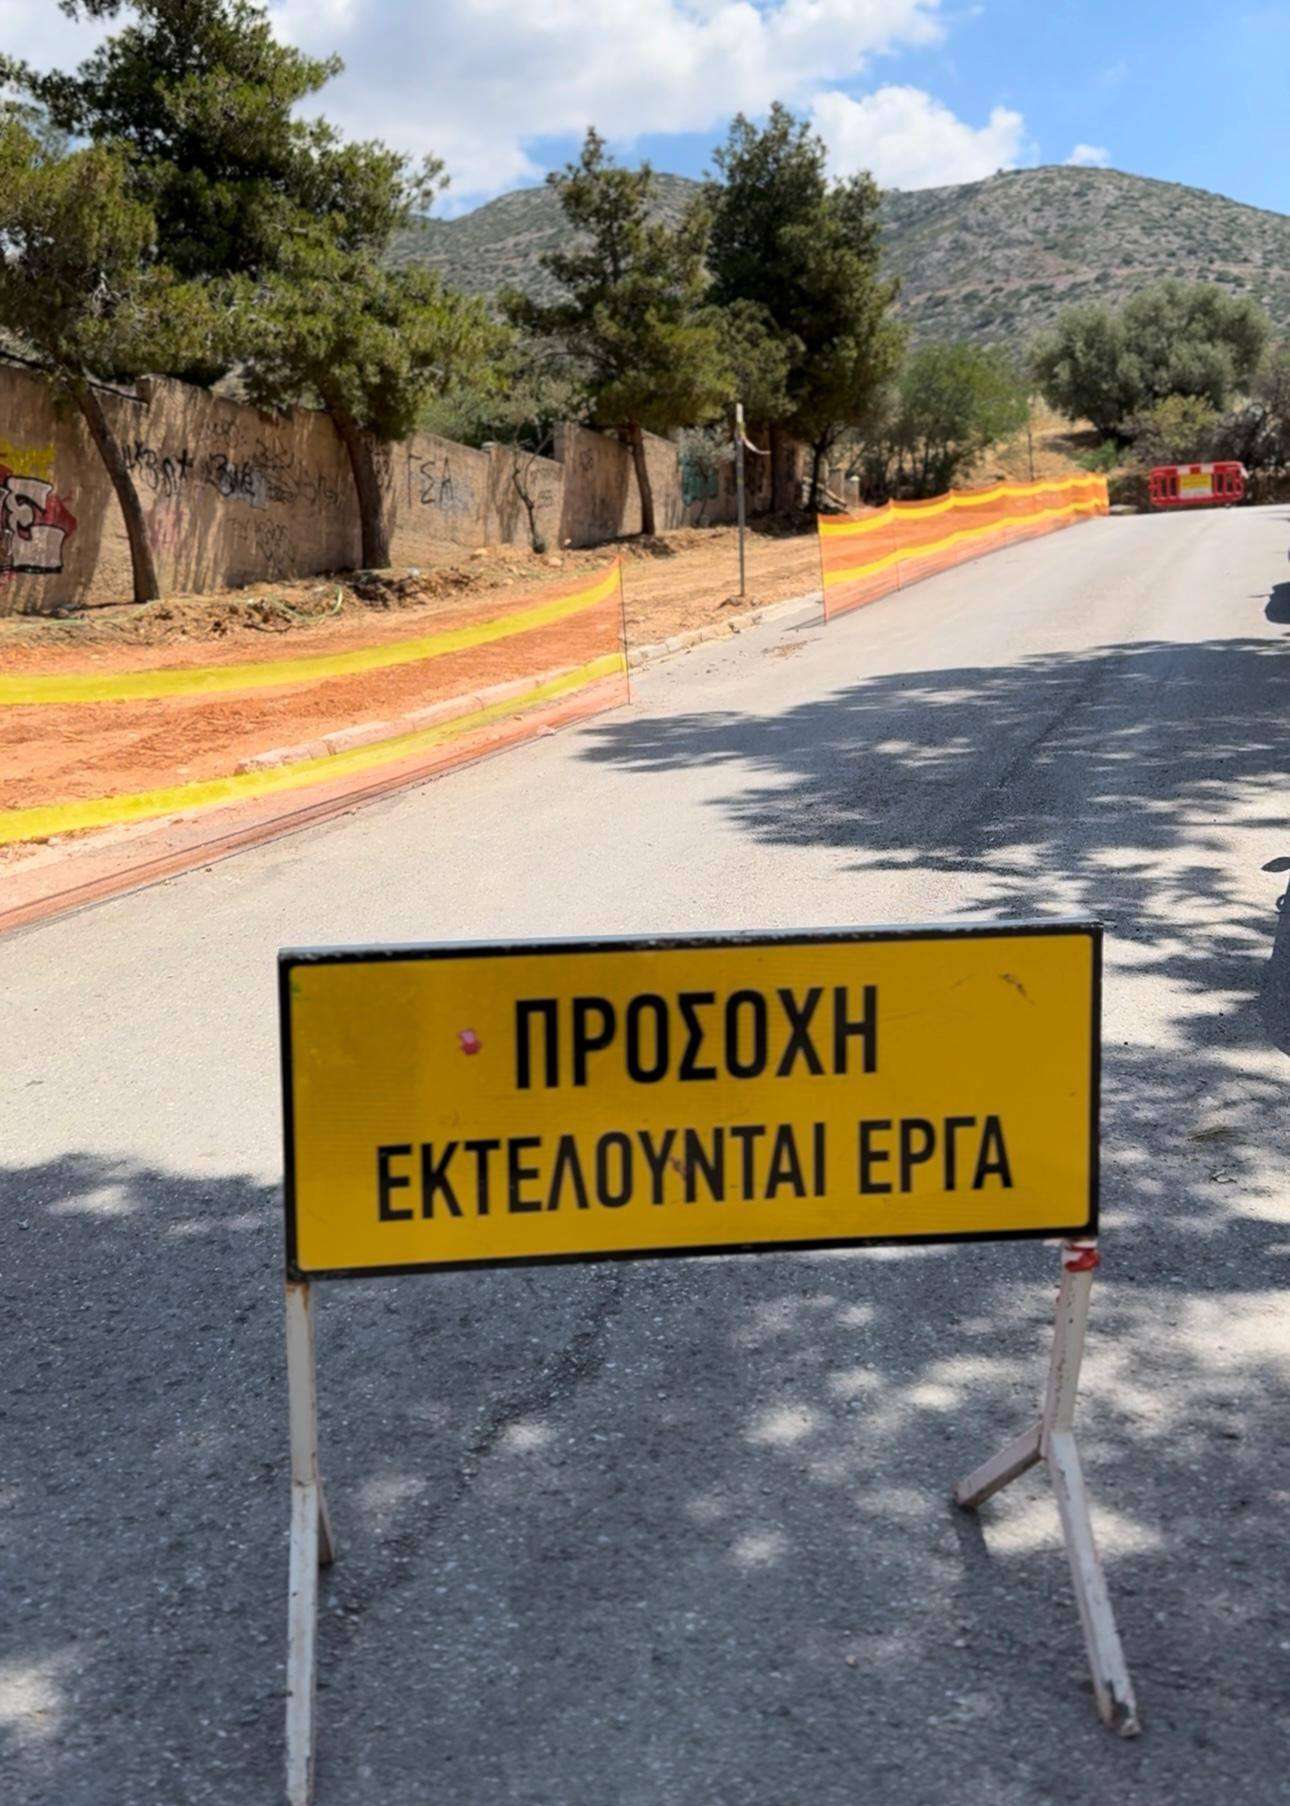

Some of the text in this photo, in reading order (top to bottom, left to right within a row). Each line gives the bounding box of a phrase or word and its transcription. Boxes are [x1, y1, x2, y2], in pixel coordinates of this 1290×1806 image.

[514, 985, 878, 1090] ΠΡΟΣΟΧΗ
[377, 1115, 1014, 1222] ΕΚΤΕΛΟΥΝΤΑΙ ΕΡΓΑ
